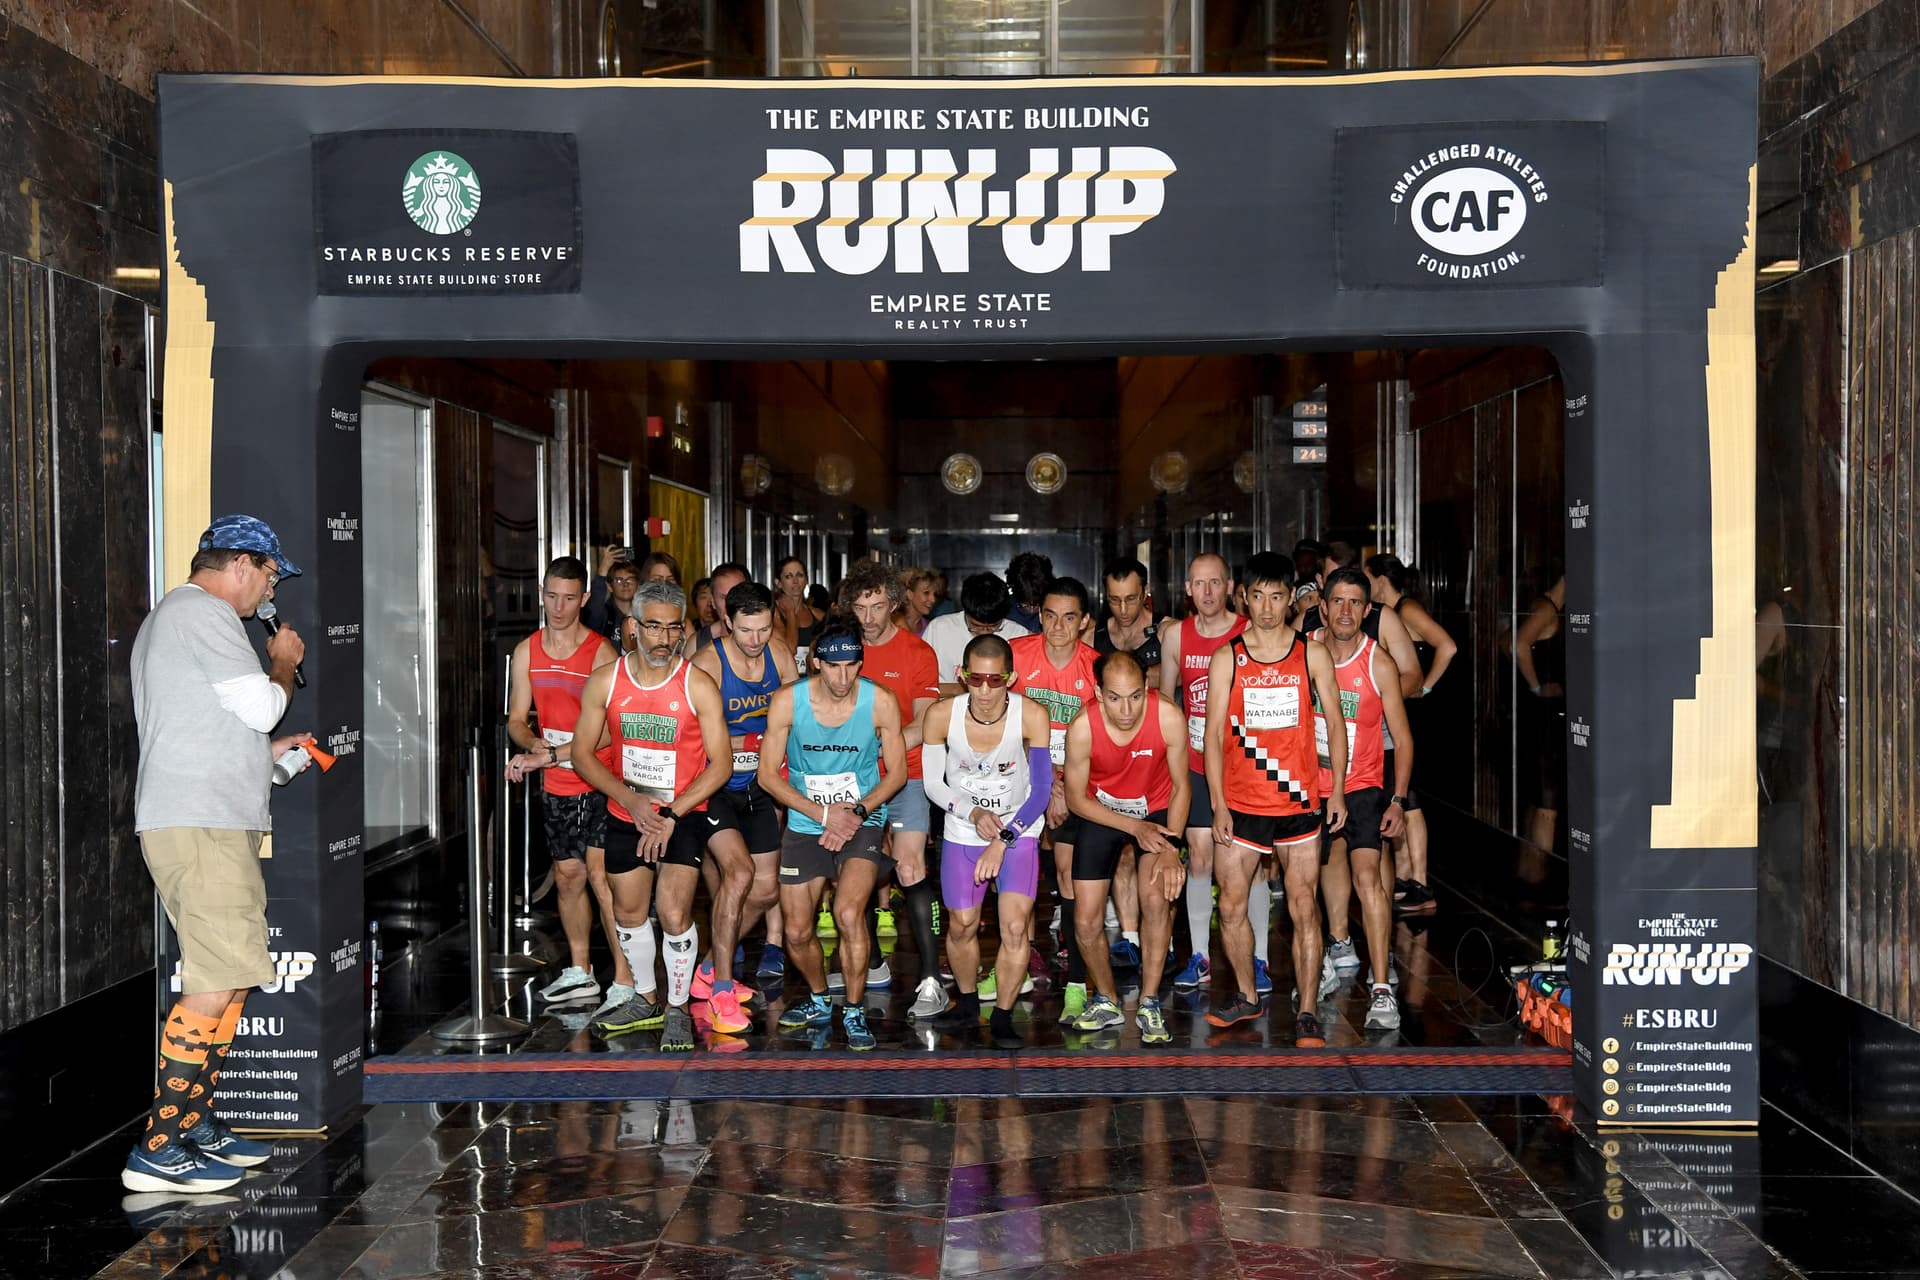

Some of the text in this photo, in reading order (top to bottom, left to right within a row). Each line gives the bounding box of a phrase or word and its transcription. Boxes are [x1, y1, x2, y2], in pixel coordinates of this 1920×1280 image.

[766, 106, 1149, 131] THE EMPIRE STATE BUILDING
[1390, 144, 1548, 204] CHALLENGED ATHLETES
[739, 146, 1177, 276] RUN-UP
[1421, 190, 1514, 233] CAF
[324, 247, 451, 262] STARBUCKS
[1416, 251, 1520, 279] FOUNDATION
[347, 273, 542, 285] EMPIRE STATE BUILDING STORE
[870, 291, 1052, 313] EMPIRE STATE
[894, 318, 1029, 330] REALTY TRUST
[328, 624, 359, 636] EMPIRE STATE
[1241, 675, 1300, 686] YOKOMORI
[1246, 708, 1297, 717] WATANABE
[621, 723, 676, 743] MEXICO
[802, 744, 860, 753] SCARPA
[631, 762, 664, 773] MORENO
[633, 771, 663, 781] VARGAS
[813, 790, 855, 806] RUGA
[971, 796, 1001, 808] SOH
[329, 835, 361, 853] EMPIRE STATE
[1638, 919, 1718, 928] EMPIRE STATE
[1651, 928, 1705, 937] BUILDING
[1602, 943, 1753, 985] RUN-UP
[1622, 1009, 1718, 1029] #ESBRU
